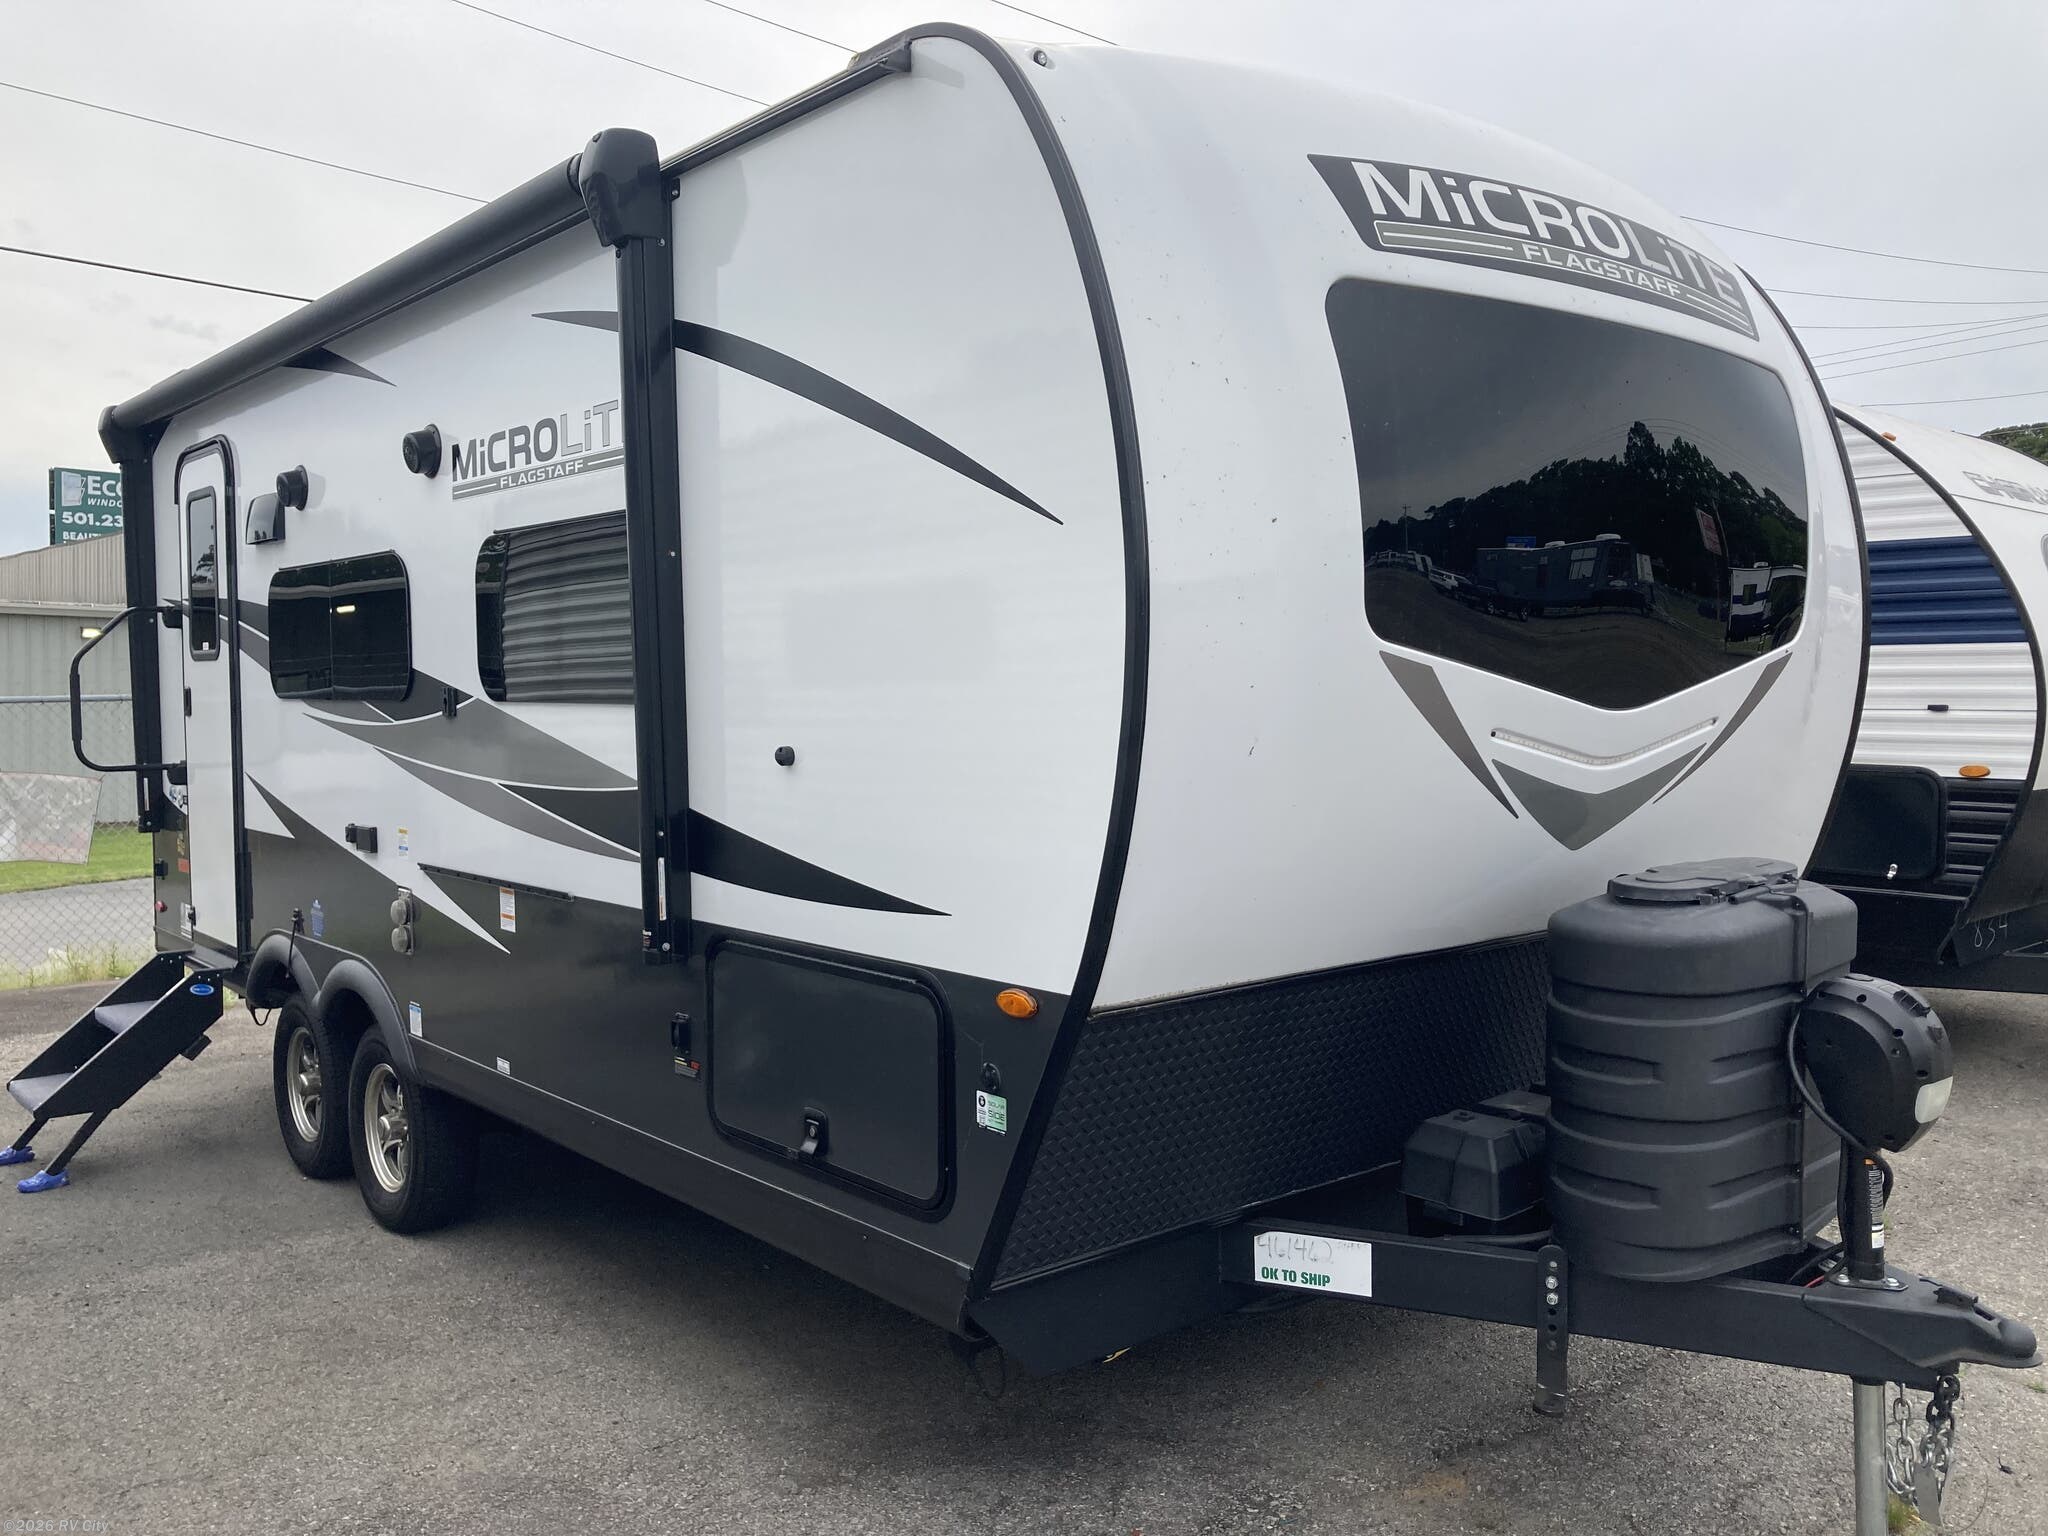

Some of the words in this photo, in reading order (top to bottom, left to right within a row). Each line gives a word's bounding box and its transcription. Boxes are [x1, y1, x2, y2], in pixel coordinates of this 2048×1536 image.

[1521, 242, 1682, 299] FLAGSTAFF
[451, 399, 625, 482] MiCROLiT
[499, 459, 585, 489] FLAGSTAFF
[1261, 1266, 1279, 1281] OK
[1281, 1269, 1297, 1283] TO
[1300, 1271, 1331, 1287] SHIP
